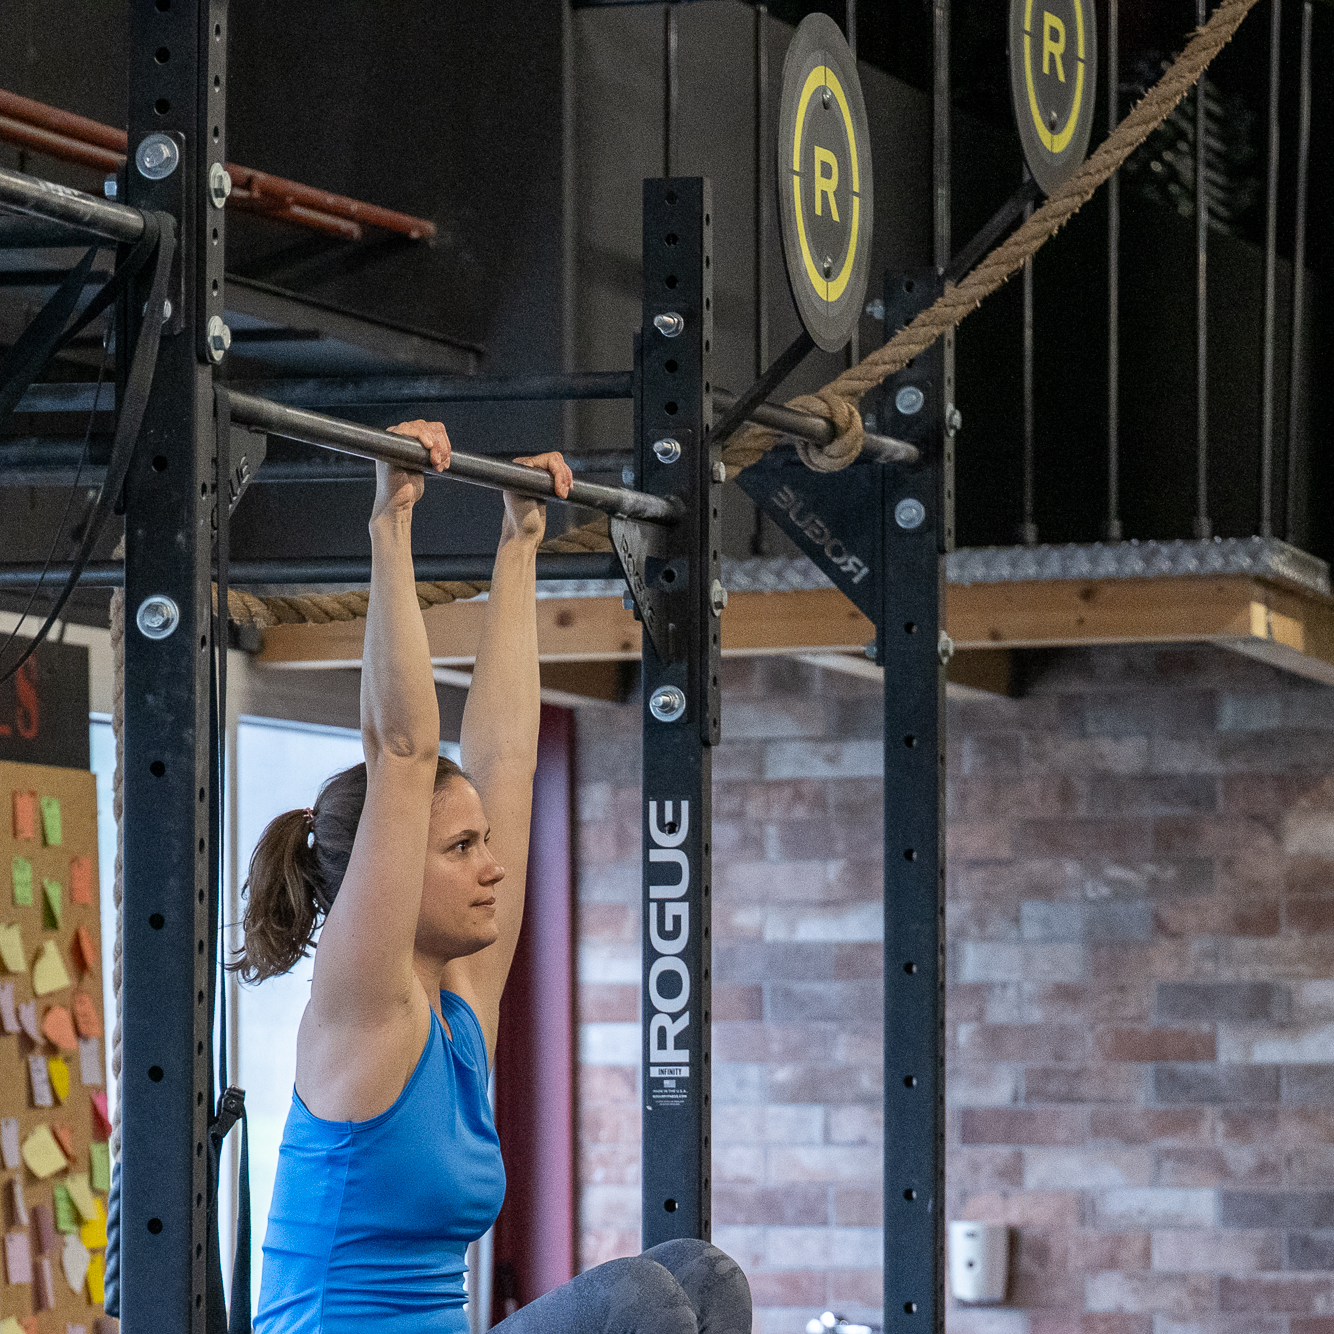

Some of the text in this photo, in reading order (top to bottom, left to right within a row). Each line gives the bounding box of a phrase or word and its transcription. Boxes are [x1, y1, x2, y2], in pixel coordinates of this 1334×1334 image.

[1043, 10, 1066, 83] R
[814, 145, 840, 222] R
[648, 800, 690, 1063] ROGUE
